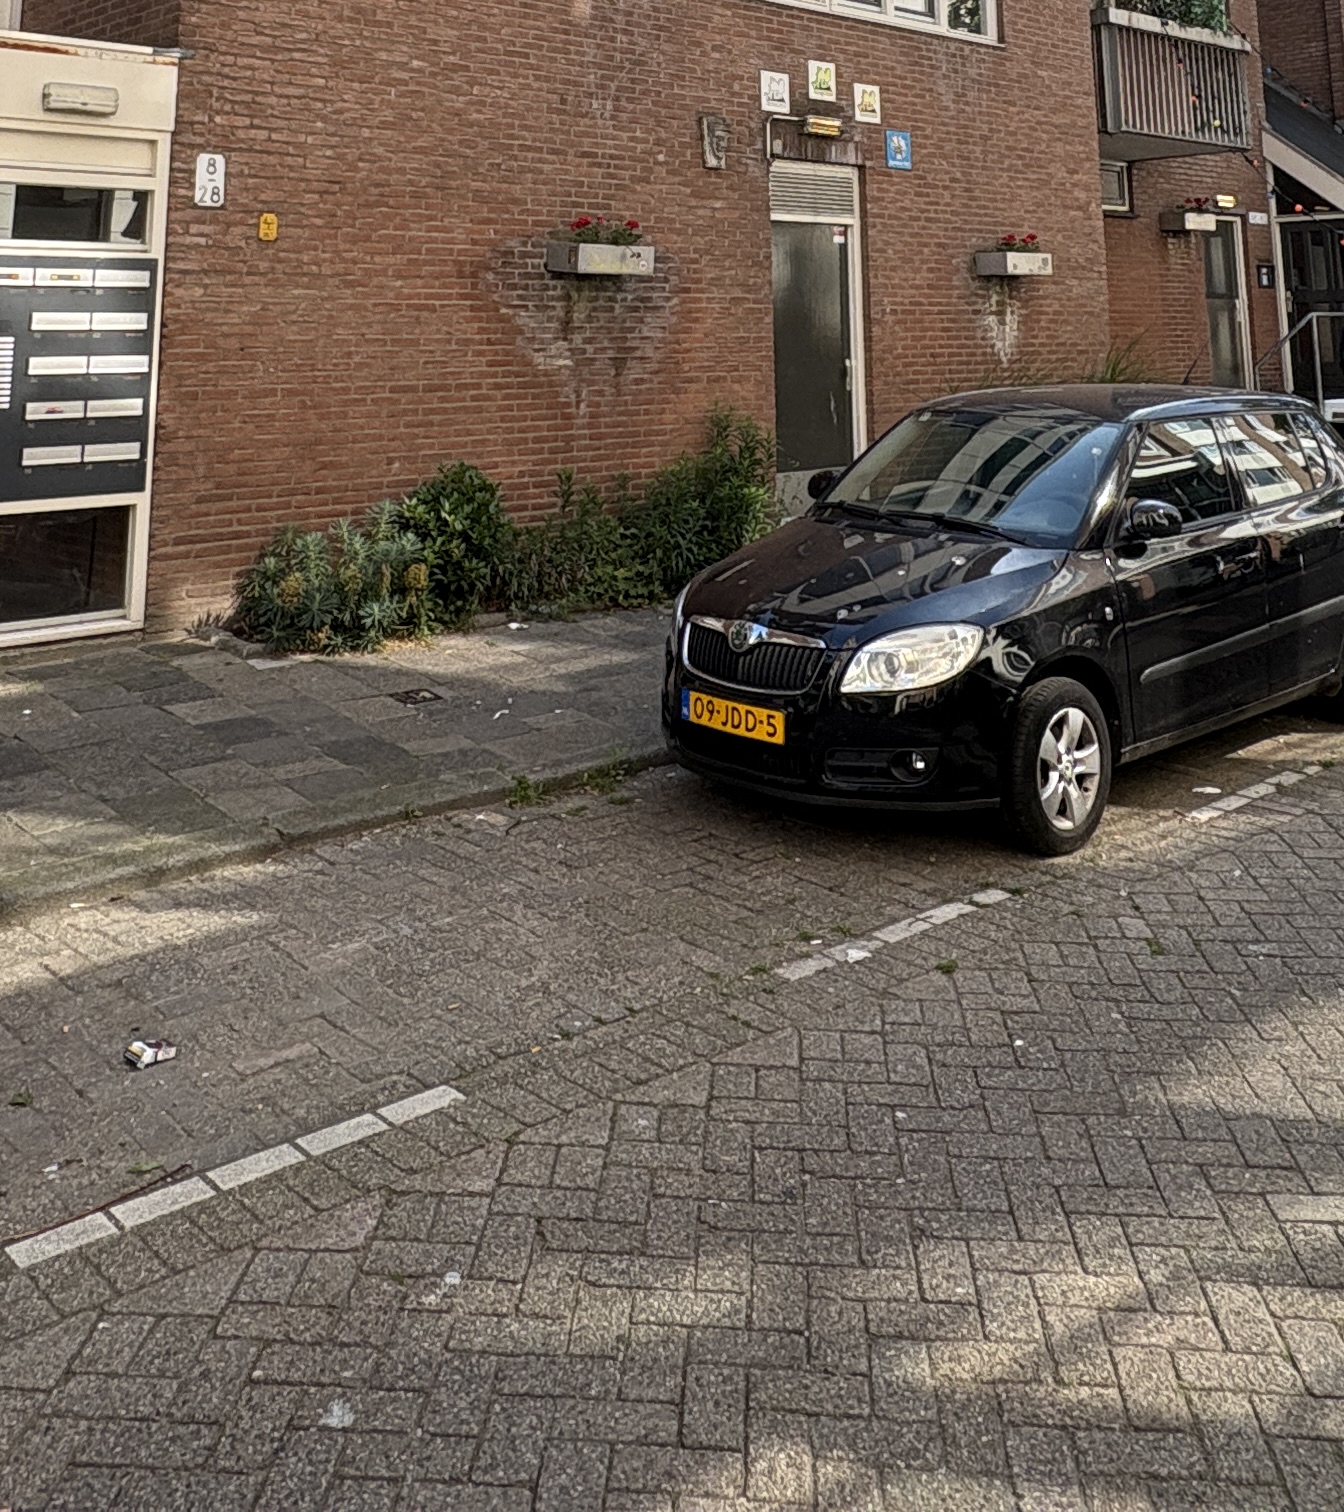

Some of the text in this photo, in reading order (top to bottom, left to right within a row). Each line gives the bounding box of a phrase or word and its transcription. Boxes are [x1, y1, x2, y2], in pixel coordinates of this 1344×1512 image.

[206, 157, 217, 175] 8
[197, 184, 221, 204] 28
[693, 696, 778, 738] 09-JDD-5
